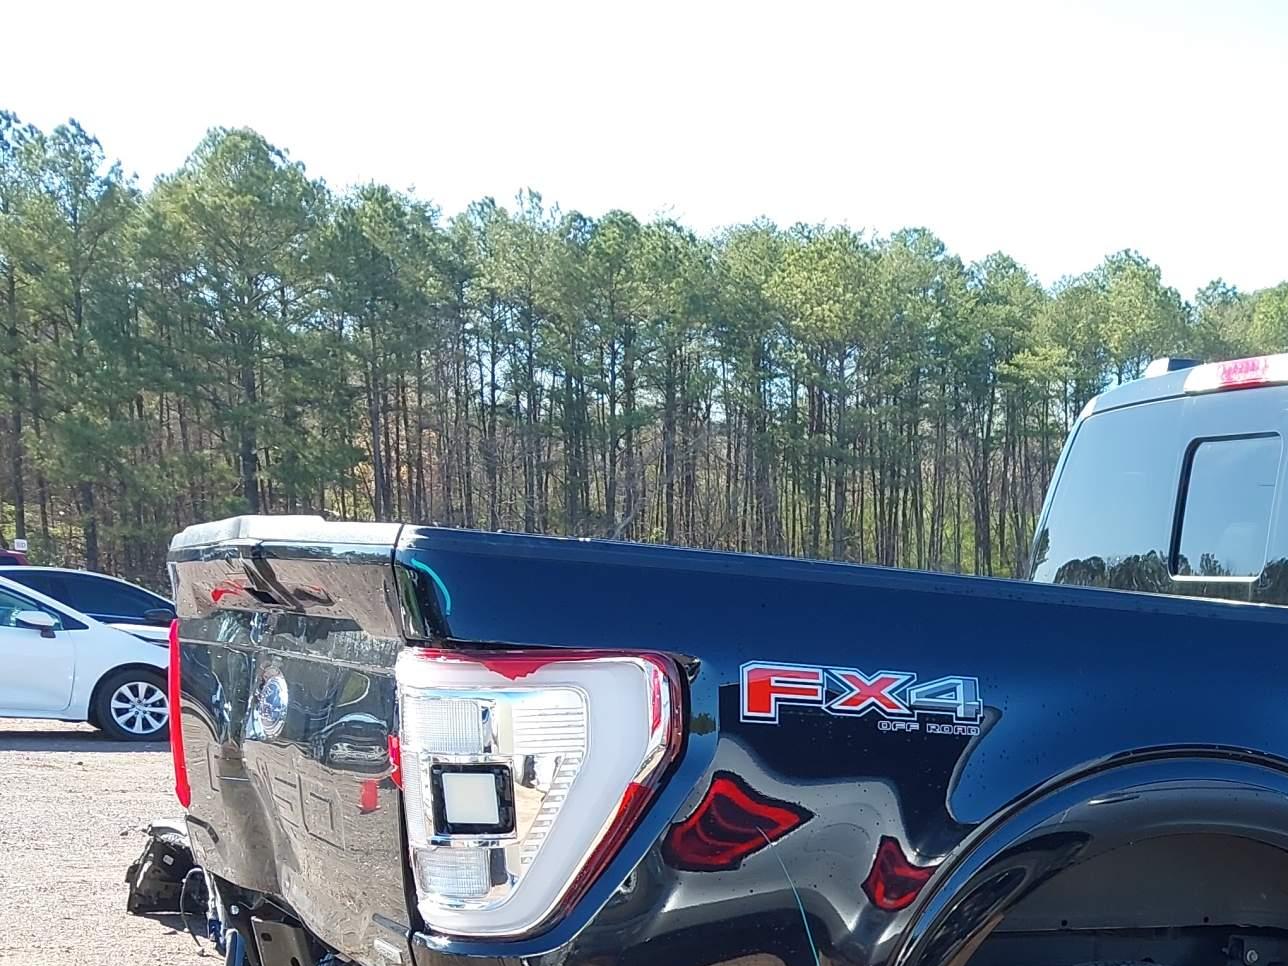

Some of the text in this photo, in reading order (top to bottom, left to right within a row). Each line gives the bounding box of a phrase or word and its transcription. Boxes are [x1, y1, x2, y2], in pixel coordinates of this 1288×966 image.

[740, 661, 983, 724] FX4
[877, 720, 980, 735] OFF ROAD
